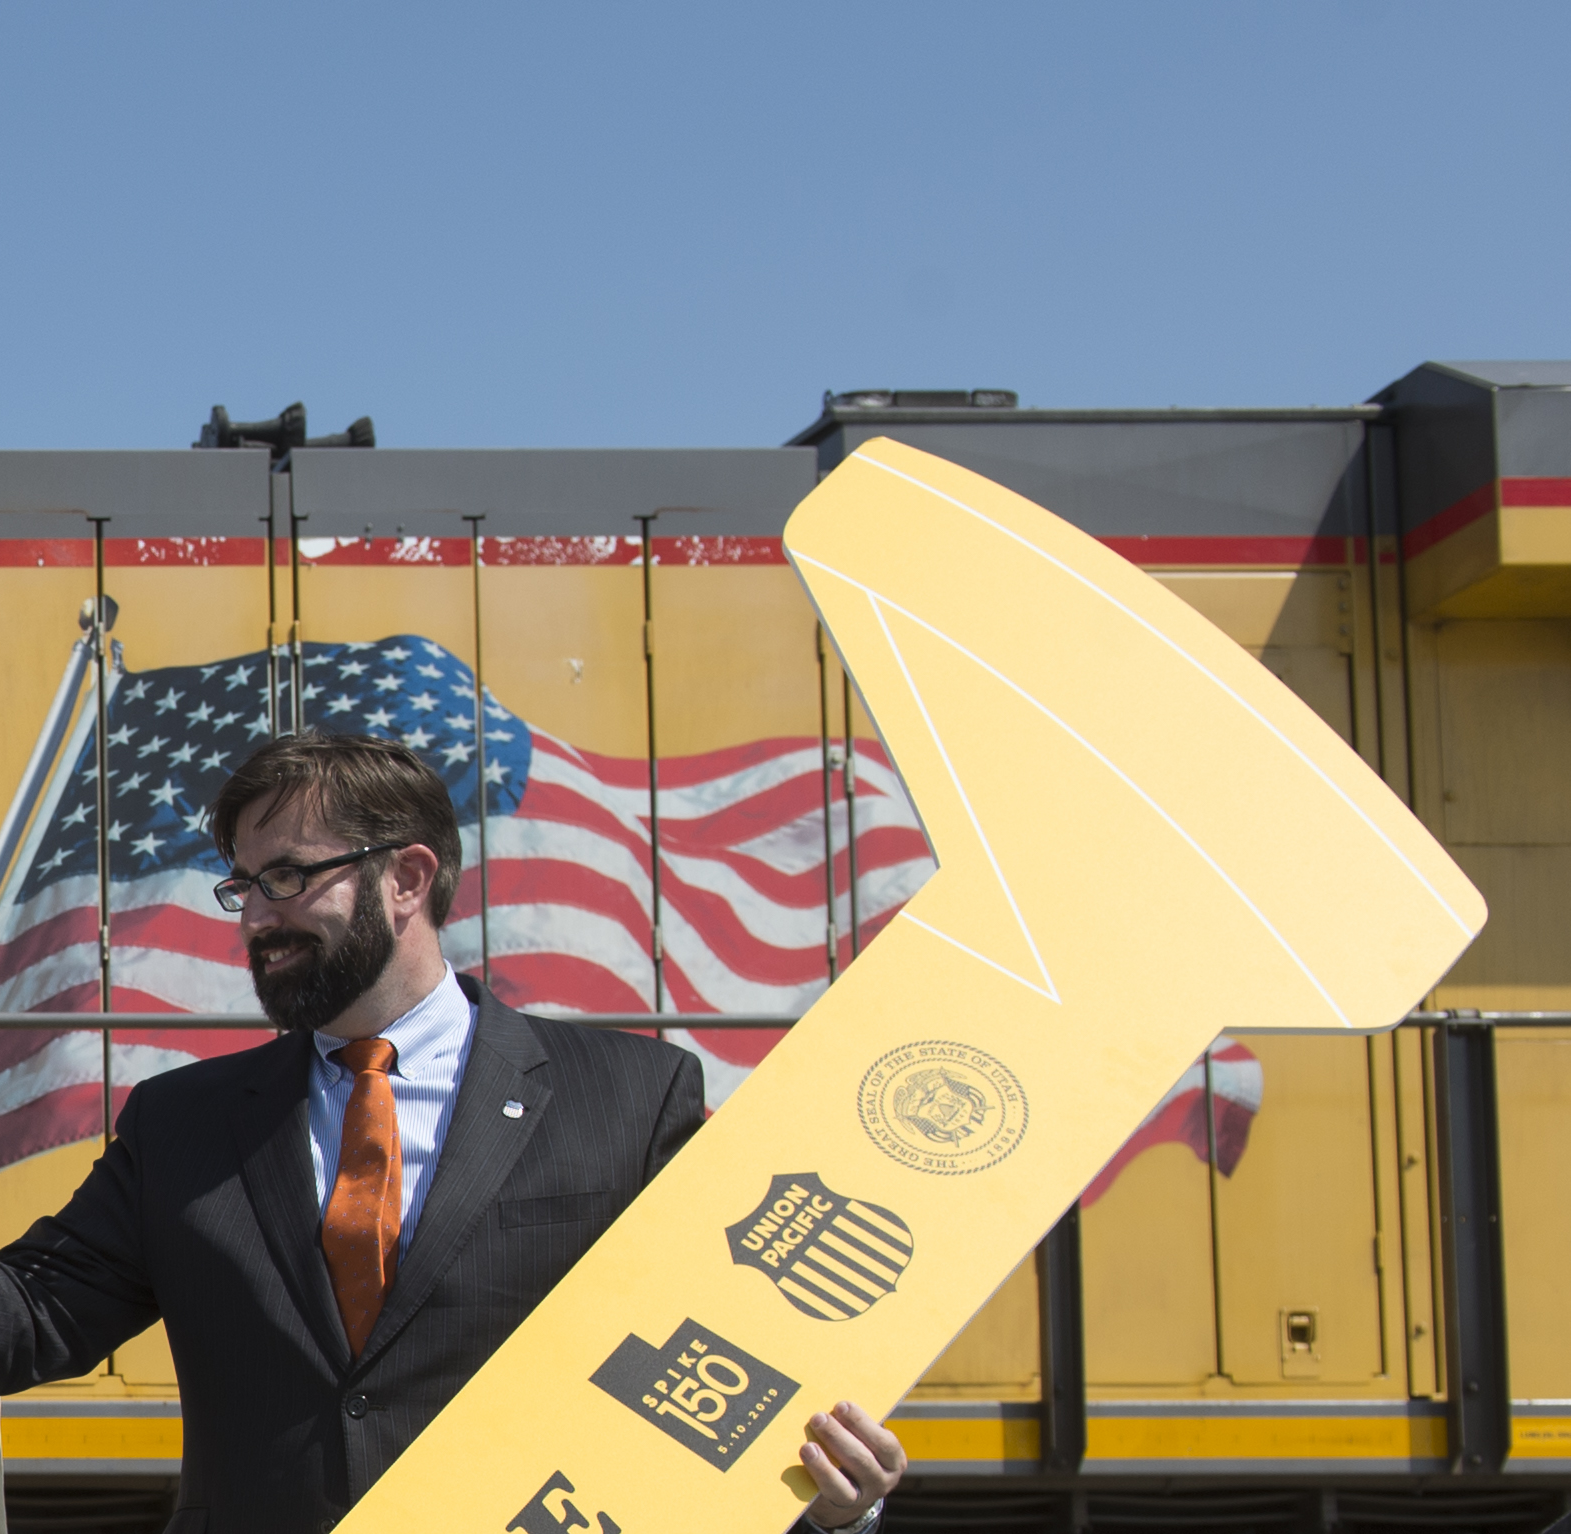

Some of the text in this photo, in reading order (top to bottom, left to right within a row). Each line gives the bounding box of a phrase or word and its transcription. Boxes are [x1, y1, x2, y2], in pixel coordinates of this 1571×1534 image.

[866, 1047, 1018, 1169] THE GREAT SEAL OF THE STATE OF UTAH
[987, 1127, 1016, 1157] 1896
[741, 1183, 810, 1252] UNION
[760, 1194, 834, 1268] PACIFIC
[642, 1338, 709, 1408] SPIKE
[656, 1354, 750, 1440] 150
[717, 1388, 779, 1454] 5.10.2019
